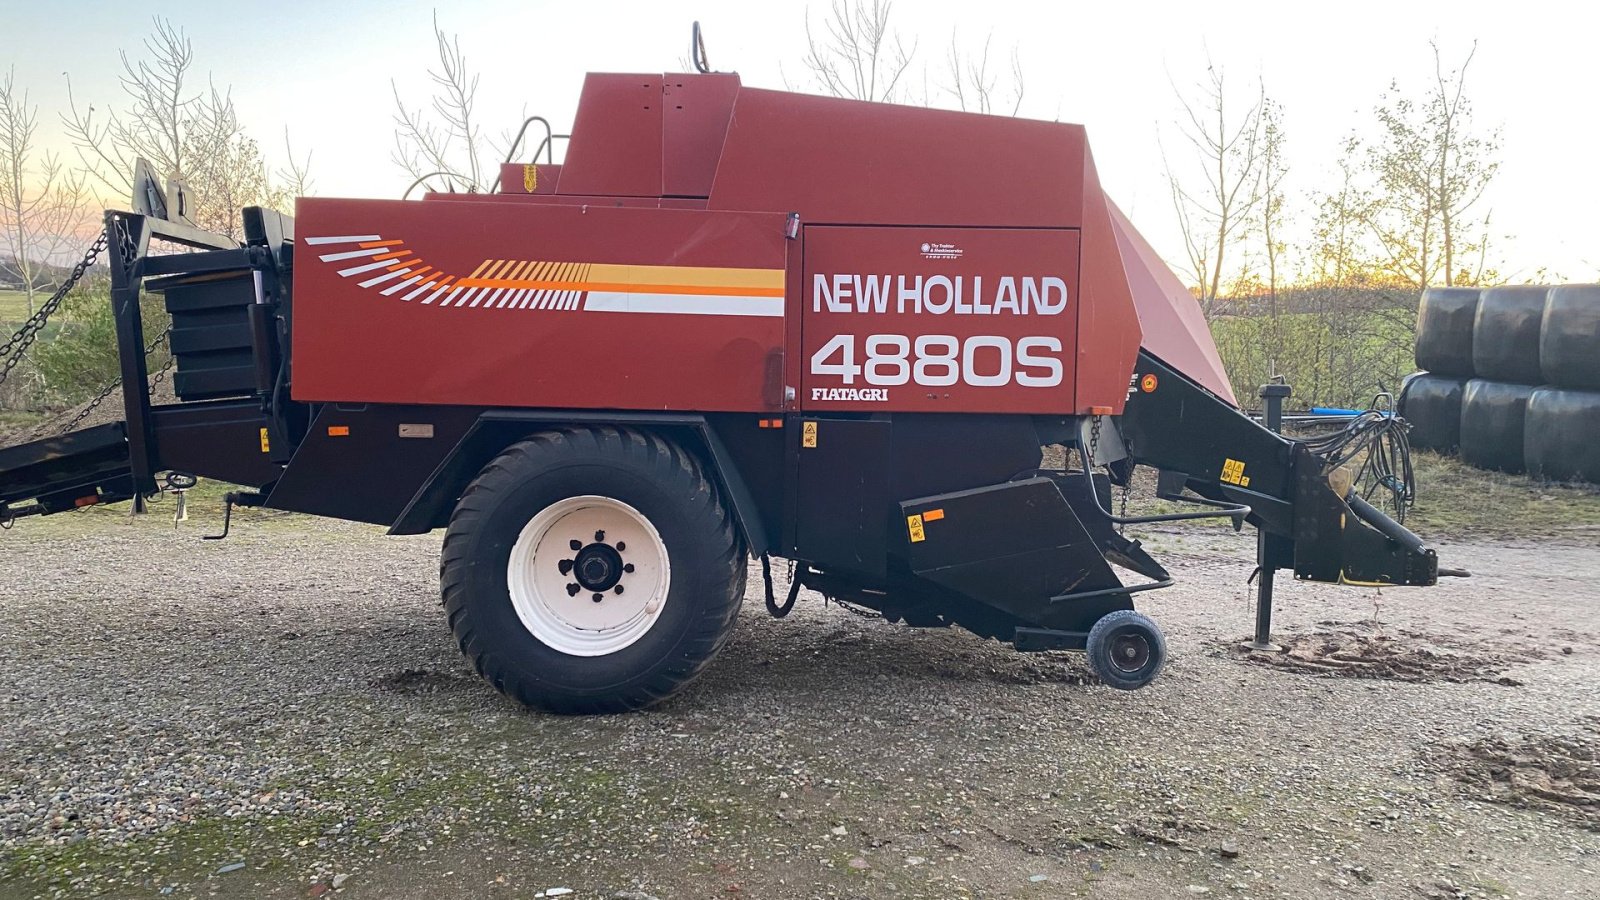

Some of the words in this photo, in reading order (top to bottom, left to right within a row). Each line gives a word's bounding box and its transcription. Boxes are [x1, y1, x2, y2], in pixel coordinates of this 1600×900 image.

[813, 273, 891, 313] NEW
[897, 275, 1068, 315] HOLLAND
[811, 334, 1063, 387] 4880S
[812, 388, 888, 401] FIATAGRI
